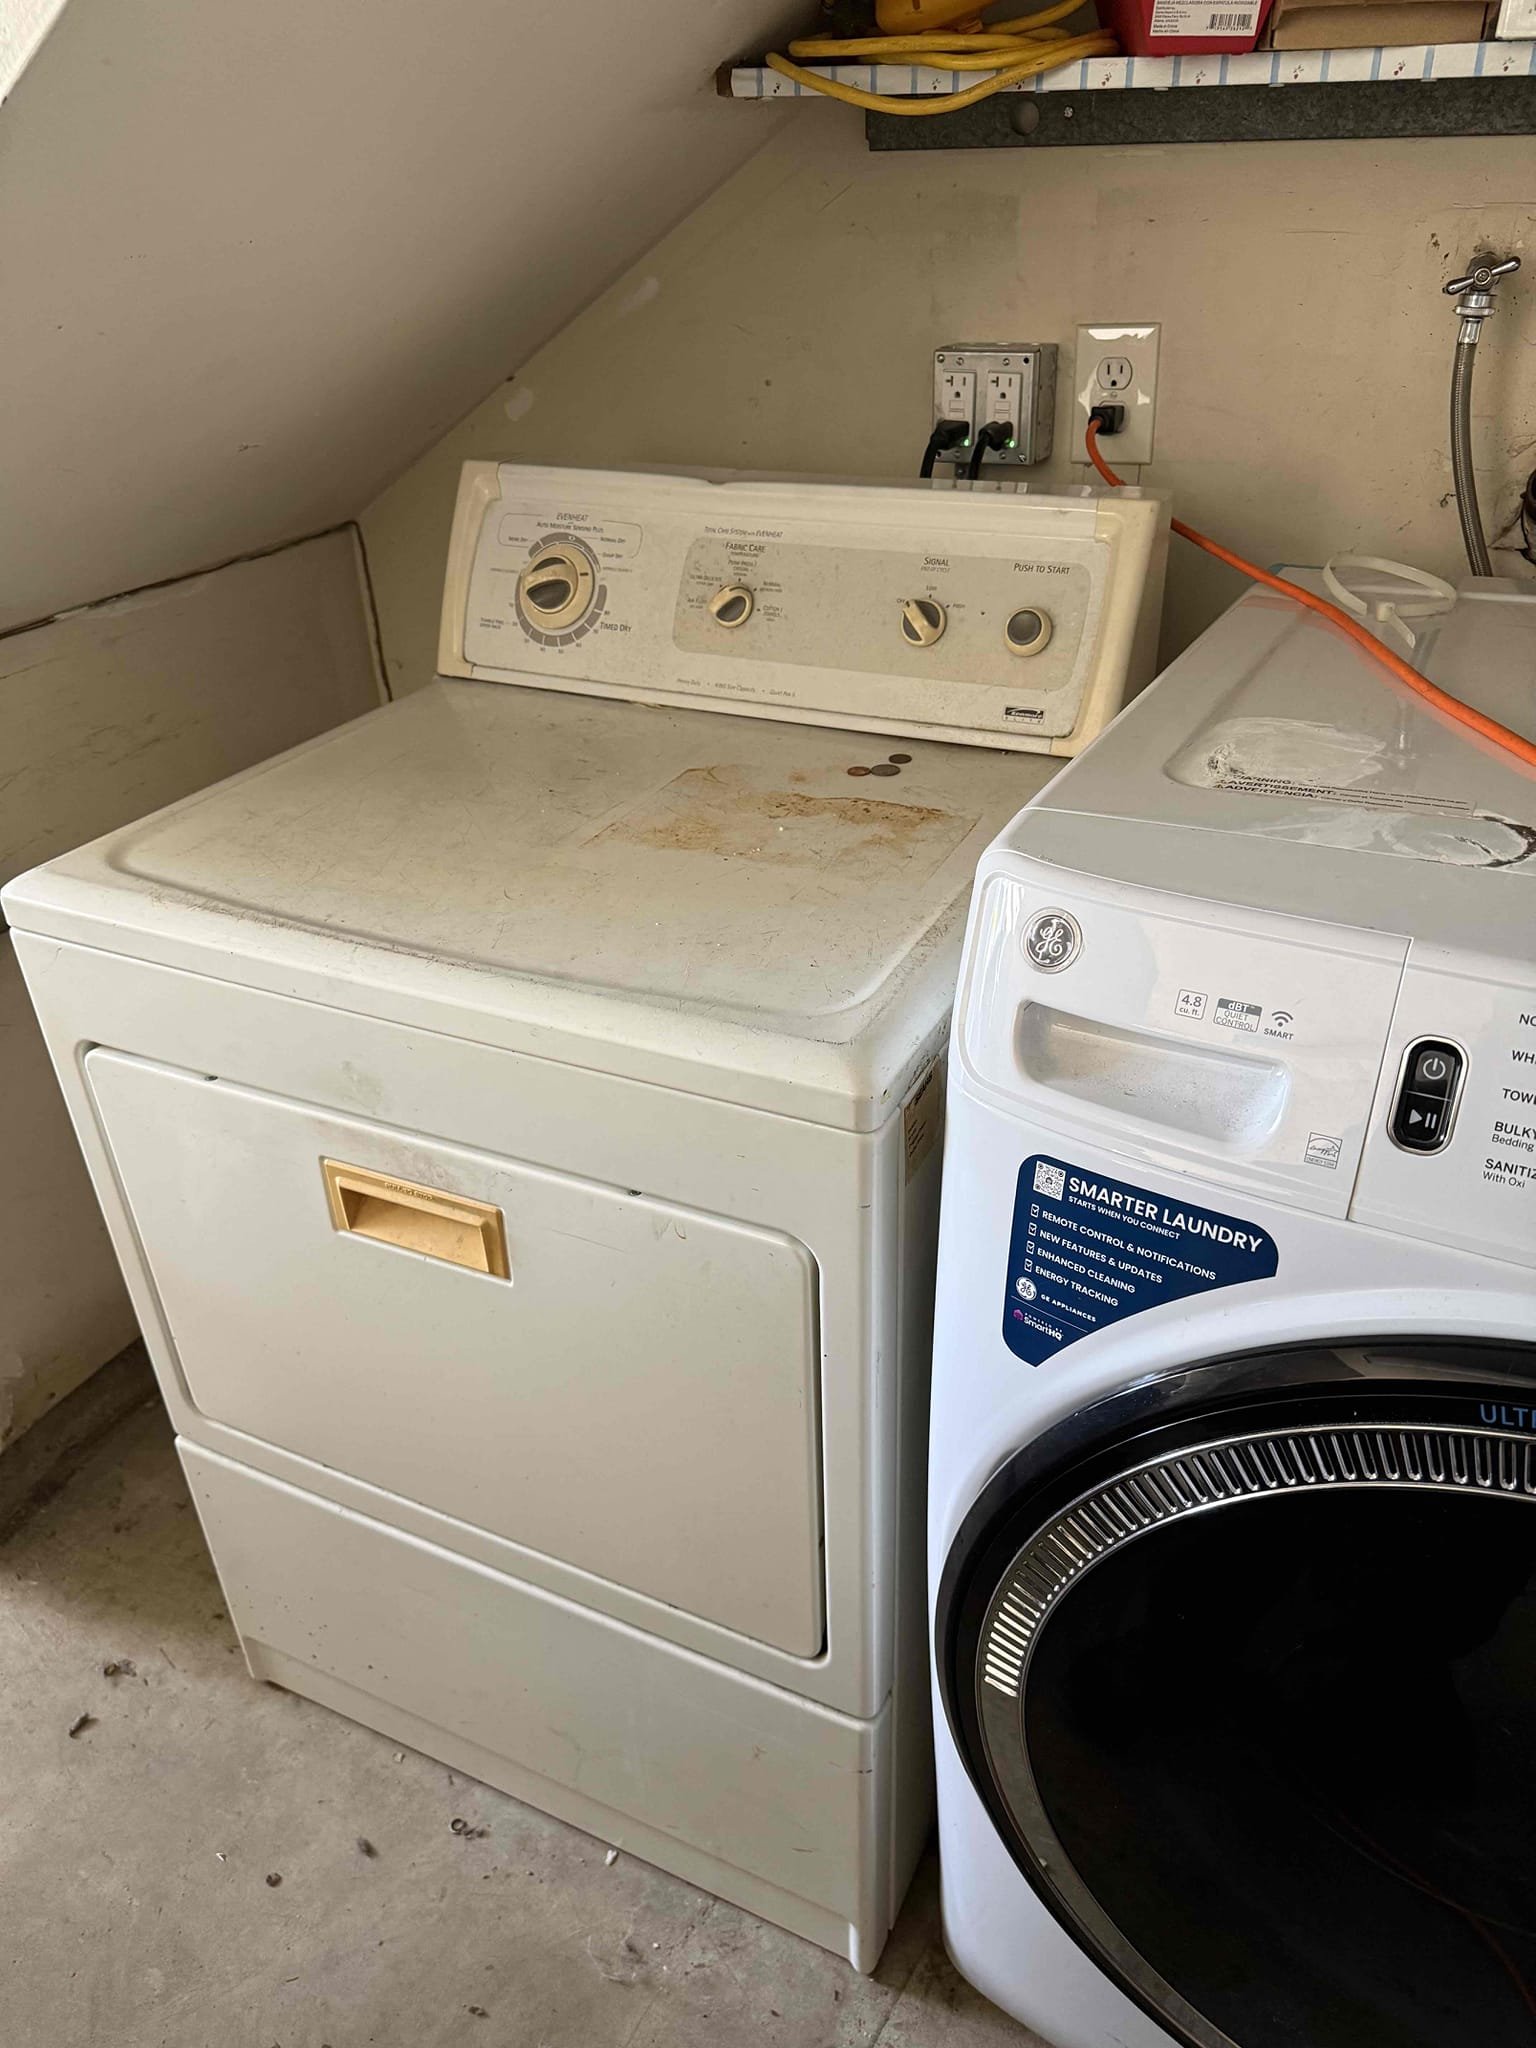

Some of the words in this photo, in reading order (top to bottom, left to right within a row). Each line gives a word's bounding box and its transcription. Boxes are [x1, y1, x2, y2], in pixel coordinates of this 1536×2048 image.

[924, 556, 950, 566] SIGNAL
[1013, 562, 1034, 573] PUSH
[1036, 565, 1045, 573] TO
[1047, 565, 1071, 575] START
[600, 621, 618, 631] TIMED
[619, 623, 633, 633] DRY
[1225, 784, 1318, 799] ADVERTENCIA:
[1228, 779, 1337, 796] AVERTISSEMENT:
[1181, 994, 1202, 1008] 4.8
[1179, 1006, 1190, 1015] cu.
[1191, 1007, 1200, 1017] ft.
[1223, 1009, 1248, 1022] QUIET
[1215, 1016, 1255, 1033] CONTROL
[1263, 1027, 1294, 1041] SMART
[1512, 1049, 1536, 1065] WH
[1491, 1133, 1534, 1152] Bedding
[1483, 1170, 1506, 1184] With
[1508, 1176, 1526, 1188] Oxi
[1068, 1177, 1158, 1220] SMARTER
[1162, 1208, 1263, 1253] LAUNDRY
[1068, 1195, 1097, 1211] STARTS
[1097, 1205, 1121, 1220] WHEN
[1121, 1214, 1139, 1227] YOU
[1139, 1219, 1181, 1240] CONNECT
[1042, 1210, 1078, 1232] REMOTE
[1079, 1225, 1125, 1250] CONTROL
[1126, 1243, 1135, 1254] &
[1136, 1246, 1216, 1281] NOTIFICATIONS
[1039, 1229, 1061, 1245] NEW
[1061, 1239, 1107, 1263] FEATURES
[1107, 1257, 1117, 1267] &
[1118, 1260, 1163, 1284] UPDATES
[1036, 1247, 1086, 1274] ENHANCED
[1087, 1268, 1136, 1294] CLEANING
[1034, 1265, 1070, 1286] ENERGY
[1070, 1280, 1119, 1307] TRACKING
[1051, 1299, 1097, 1322] APPLIANCES
[1023, 1316, 1063, 1341] SmartHQ
[1480, 1403, 1536, 1429] ULT
